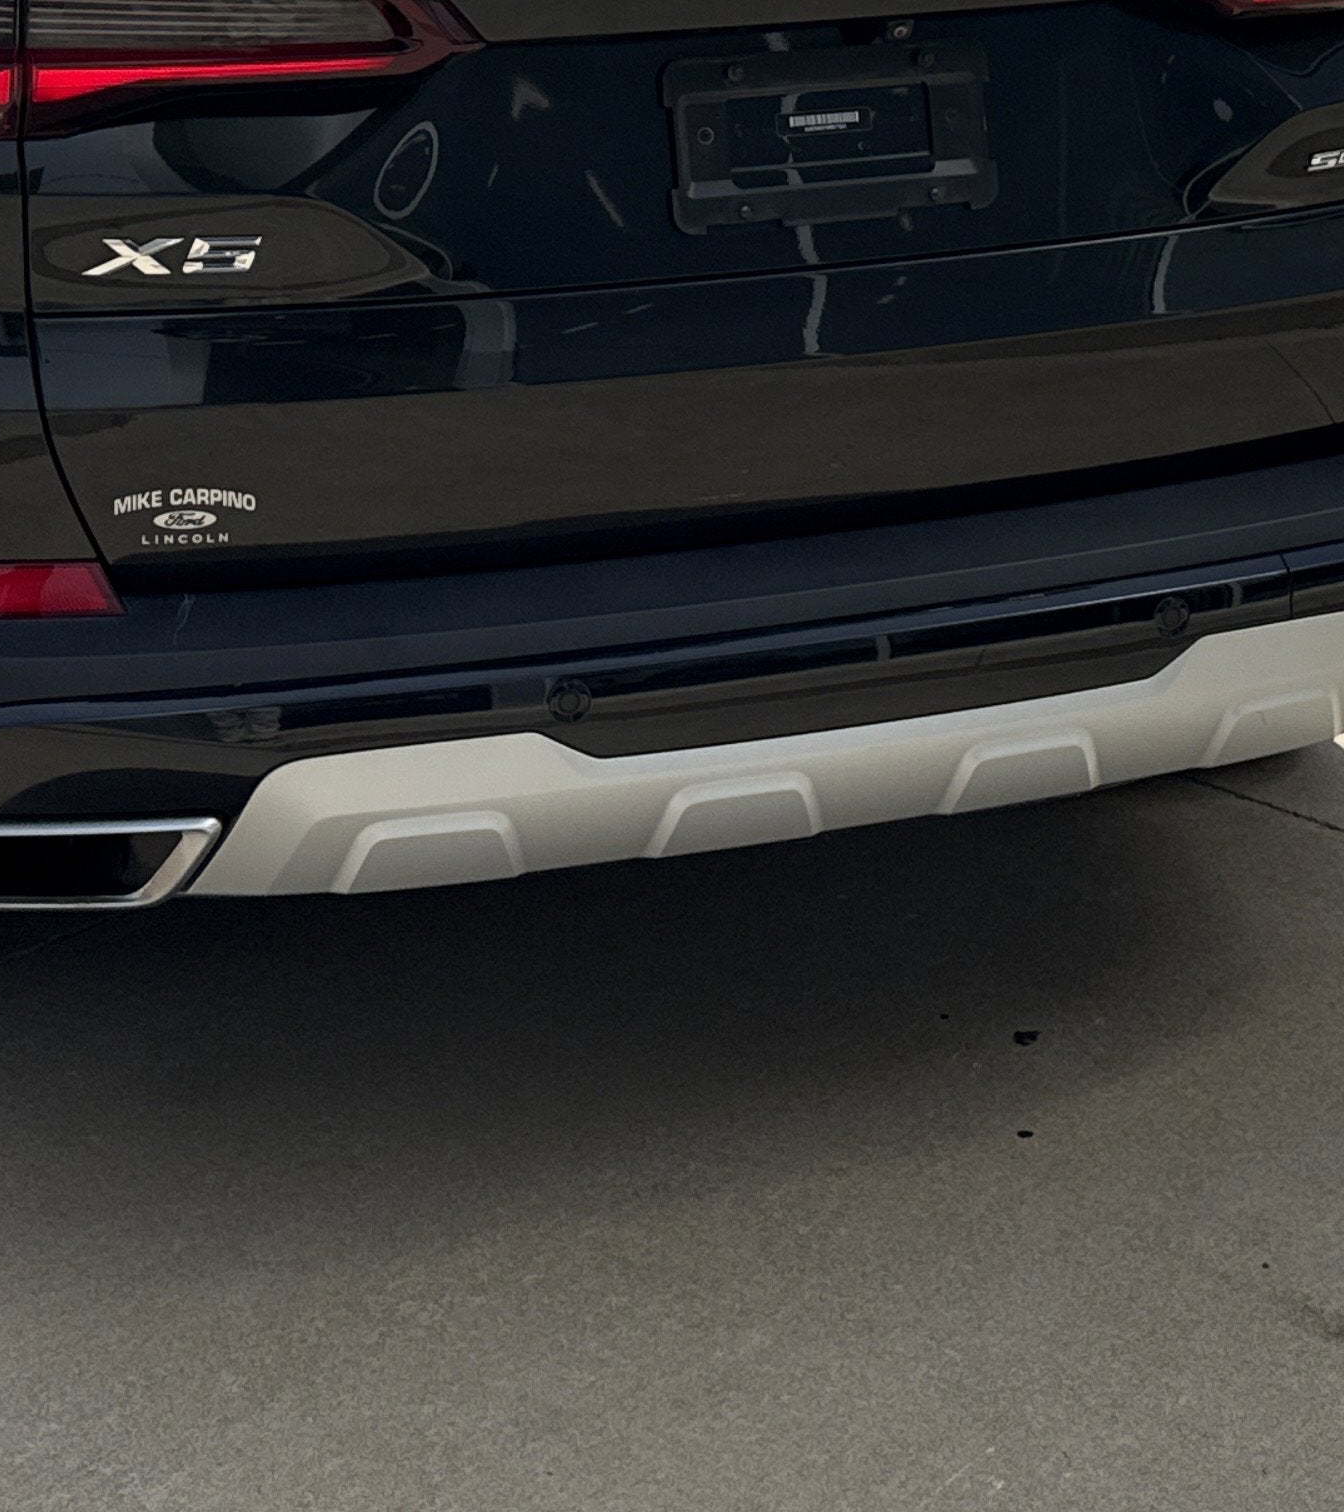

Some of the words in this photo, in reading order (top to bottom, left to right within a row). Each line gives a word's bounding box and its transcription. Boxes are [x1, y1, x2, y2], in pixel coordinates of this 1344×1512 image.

[81, 236, 262, 276] X5
[113, 490, 163, 516] MIKE
[169, 488, 256, 511] CARPINO
[163, 512, 205, 527] Ford
[141, 532, 229, 545] LINCOLN
